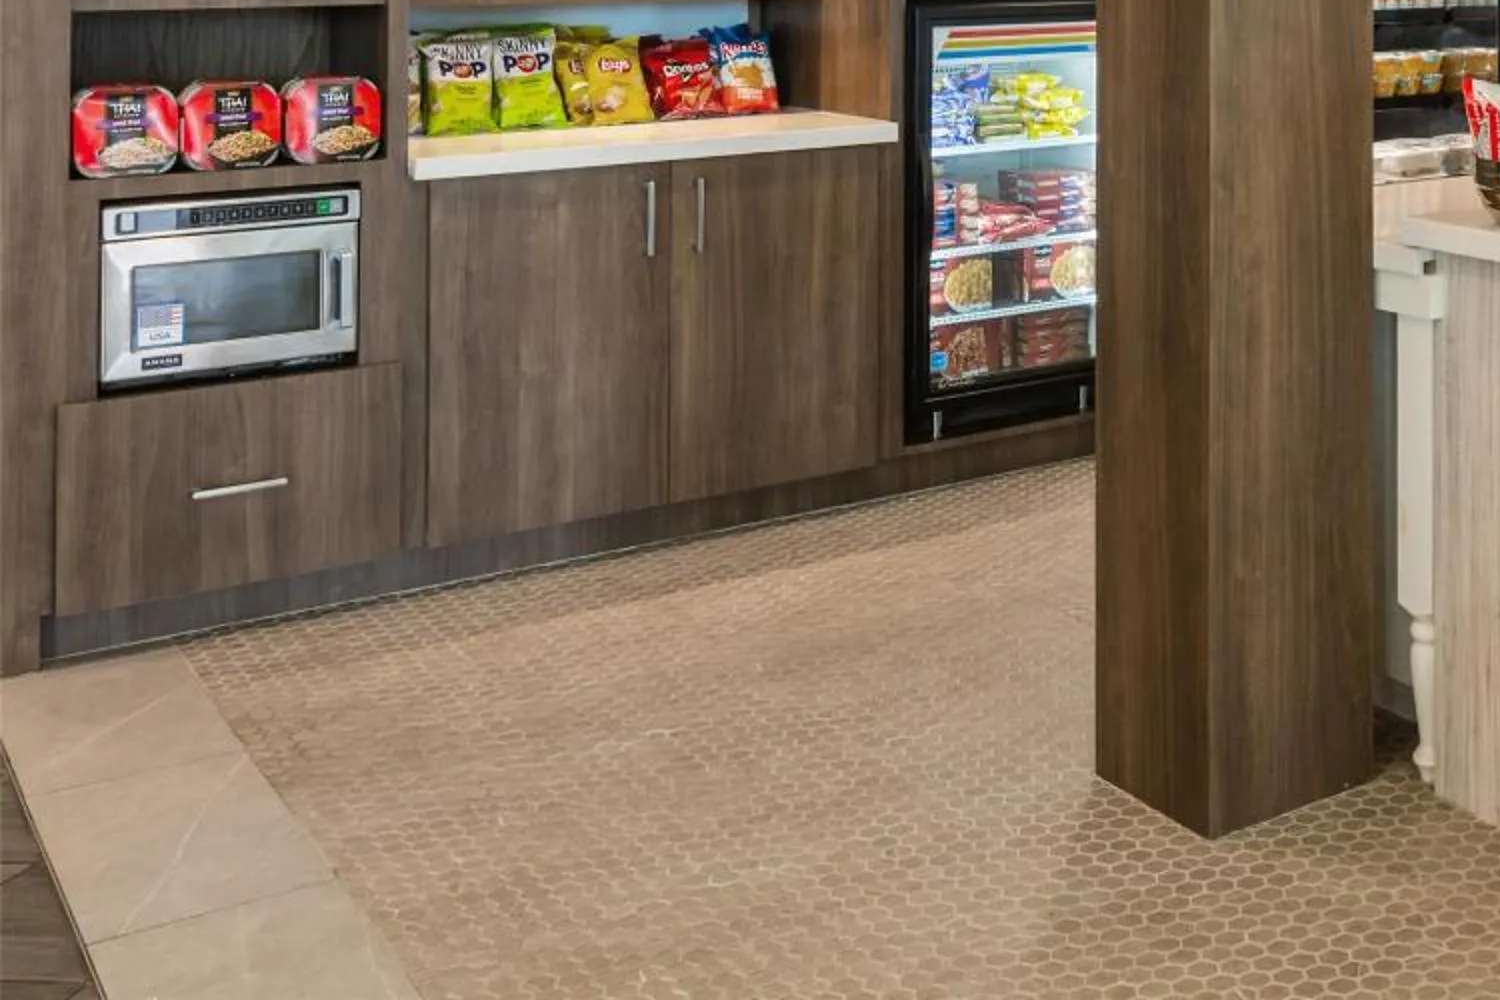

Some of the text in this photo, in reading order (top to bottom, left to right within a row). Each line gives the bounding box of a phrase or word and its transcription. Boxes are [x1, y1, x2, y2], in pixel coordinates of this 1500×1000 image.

[438, 60, 487, 79] POP
[503, 52, 550, 74] POP
[218, 97, 247, 110] THAI
[320, 92, 350, 105] THAI
[110, 103, 142, 116] THAI
